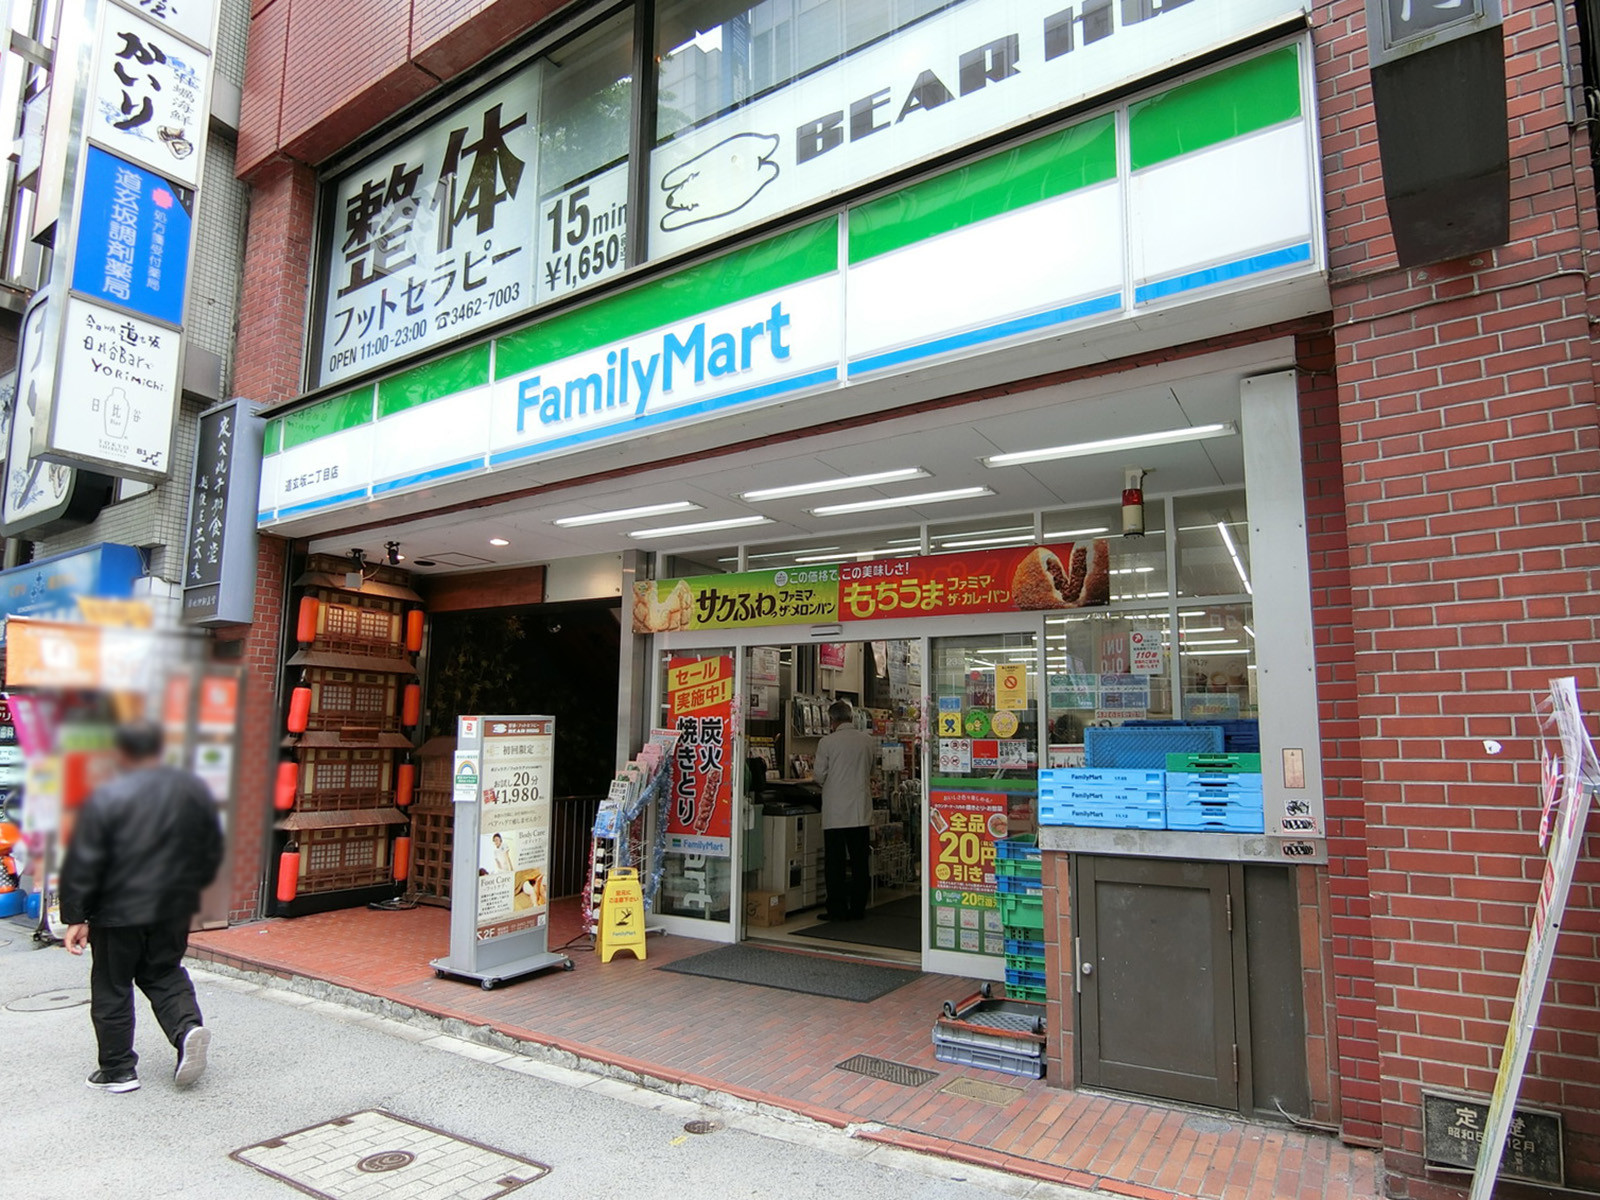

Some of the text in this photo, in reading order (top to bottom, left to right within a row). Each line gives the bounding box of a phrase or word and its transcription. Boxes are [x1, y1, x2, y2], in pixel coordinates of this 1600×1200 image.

[114, 32, 166, 130] かいり
[796, 33, 1021, 166] BEAR
[337, 102, 527, 300] 整体
[103, 166, 142, 300] 道玄坂調剤薬局
[545, 234, 619, 291] ¥1,650
[333, 239, 522, 346] フットセラピー
[329, 346, 357, 373] OPEN
[360, 319, 427, 360] 11:00-23:00
[516, 301, 791, 433] FamilyMart
[285, 465, 339, 492] 道玄坂二丁目店
[843, 578, 944, 618] もちうま
[676, 663, 717, 686] セール
[676, 684, 727, 712] 実施中!
[503, 745, 534, 755] 初回限定
[699, 716, 723, 771] 炭火
[676, 716, 699, 826] 焼きとり
[949, 812, 985, 833] 全品
[1071, 810, 1104, 818] FamilyMart
[519, 829, 546, 839] Body Care
[682, 838, 725, 851] FamilyMart
[481, 876, 511, 887] Foot Care
[953, 864, 983, 882] 引き
[483, 928, 495, 940] 2F
[1455, 1107, 1479, 1129] 定
